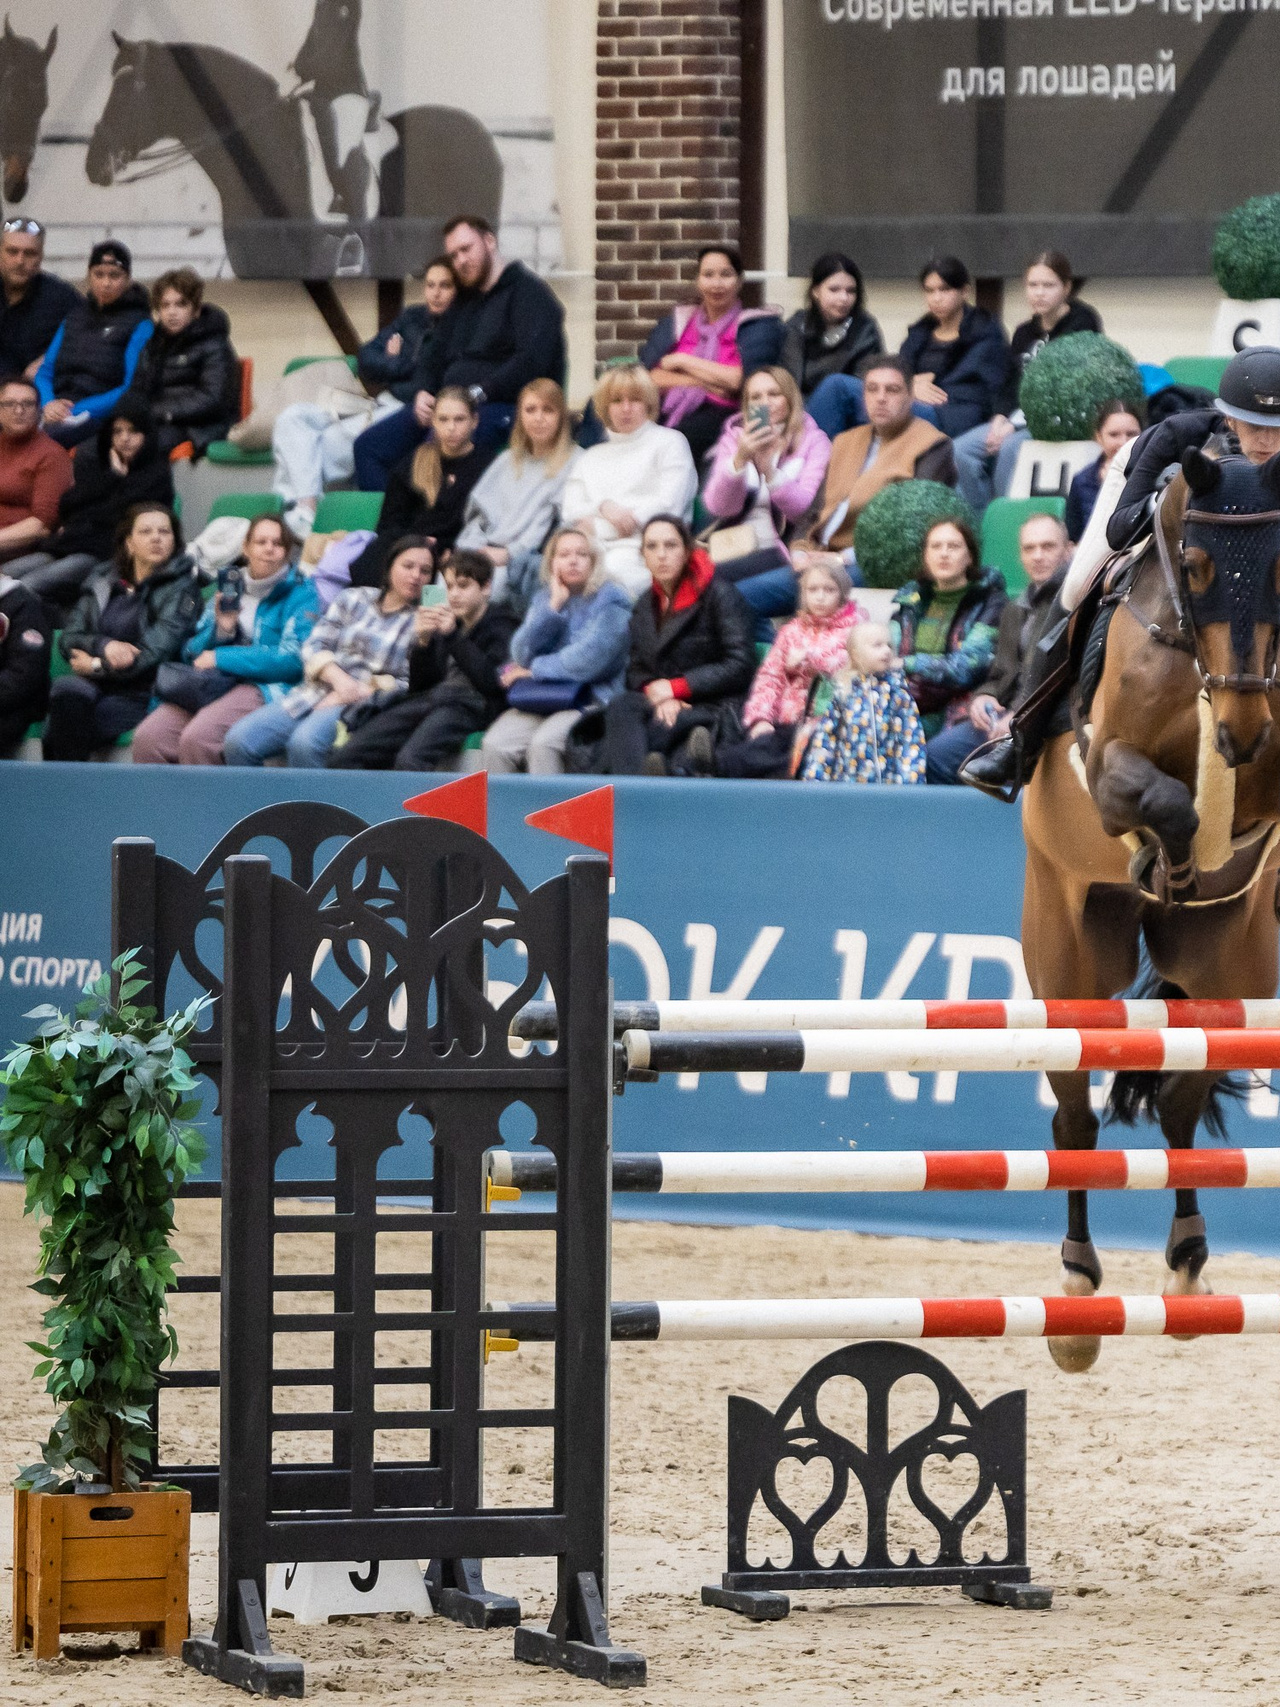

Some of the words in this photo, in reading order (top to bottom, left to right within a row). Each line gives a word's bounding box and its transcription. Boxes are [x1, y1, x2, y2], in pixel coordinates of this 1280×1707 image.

[942, 67, 1005, 101] для
[1017, 50, 1177, 99] лошадей
[9, 955, 102, 988] СПОРТА
